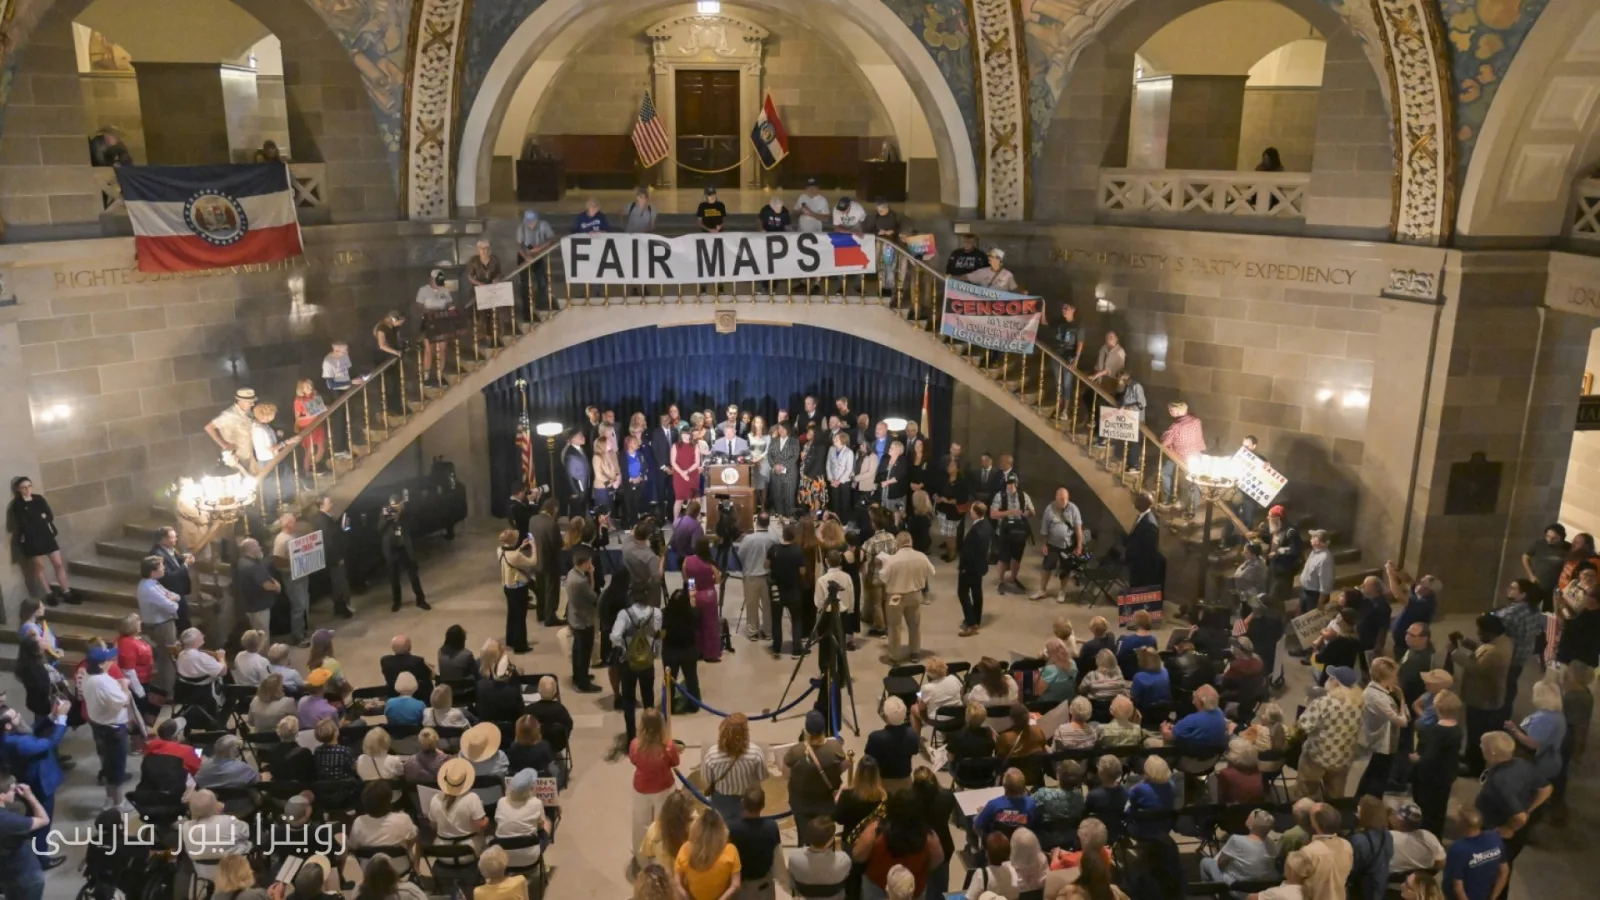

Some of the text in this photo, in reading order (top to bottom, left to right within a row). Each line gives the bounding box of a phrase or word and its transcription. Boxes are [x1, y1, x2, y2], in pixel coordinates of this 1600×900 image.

[570, 233, 823, 279] FAIR MAPS
[1097, 251, 1168, 270] HONESTY
[1190, 256, 1243, 277] PARTY
[1245, 262, 1357, 286] EXPEDIENCY
[982, 291, 1001, 299] NOT
[952, 300, 1037, 315] CENSOR
[953, 329, 1027, 351] IGNORANCE
[1105, 420, 1134, 430] DICTATOR
[1116, 415, 1126, 423] NO
[1103, 429, 1135, 440] MISSOURI
